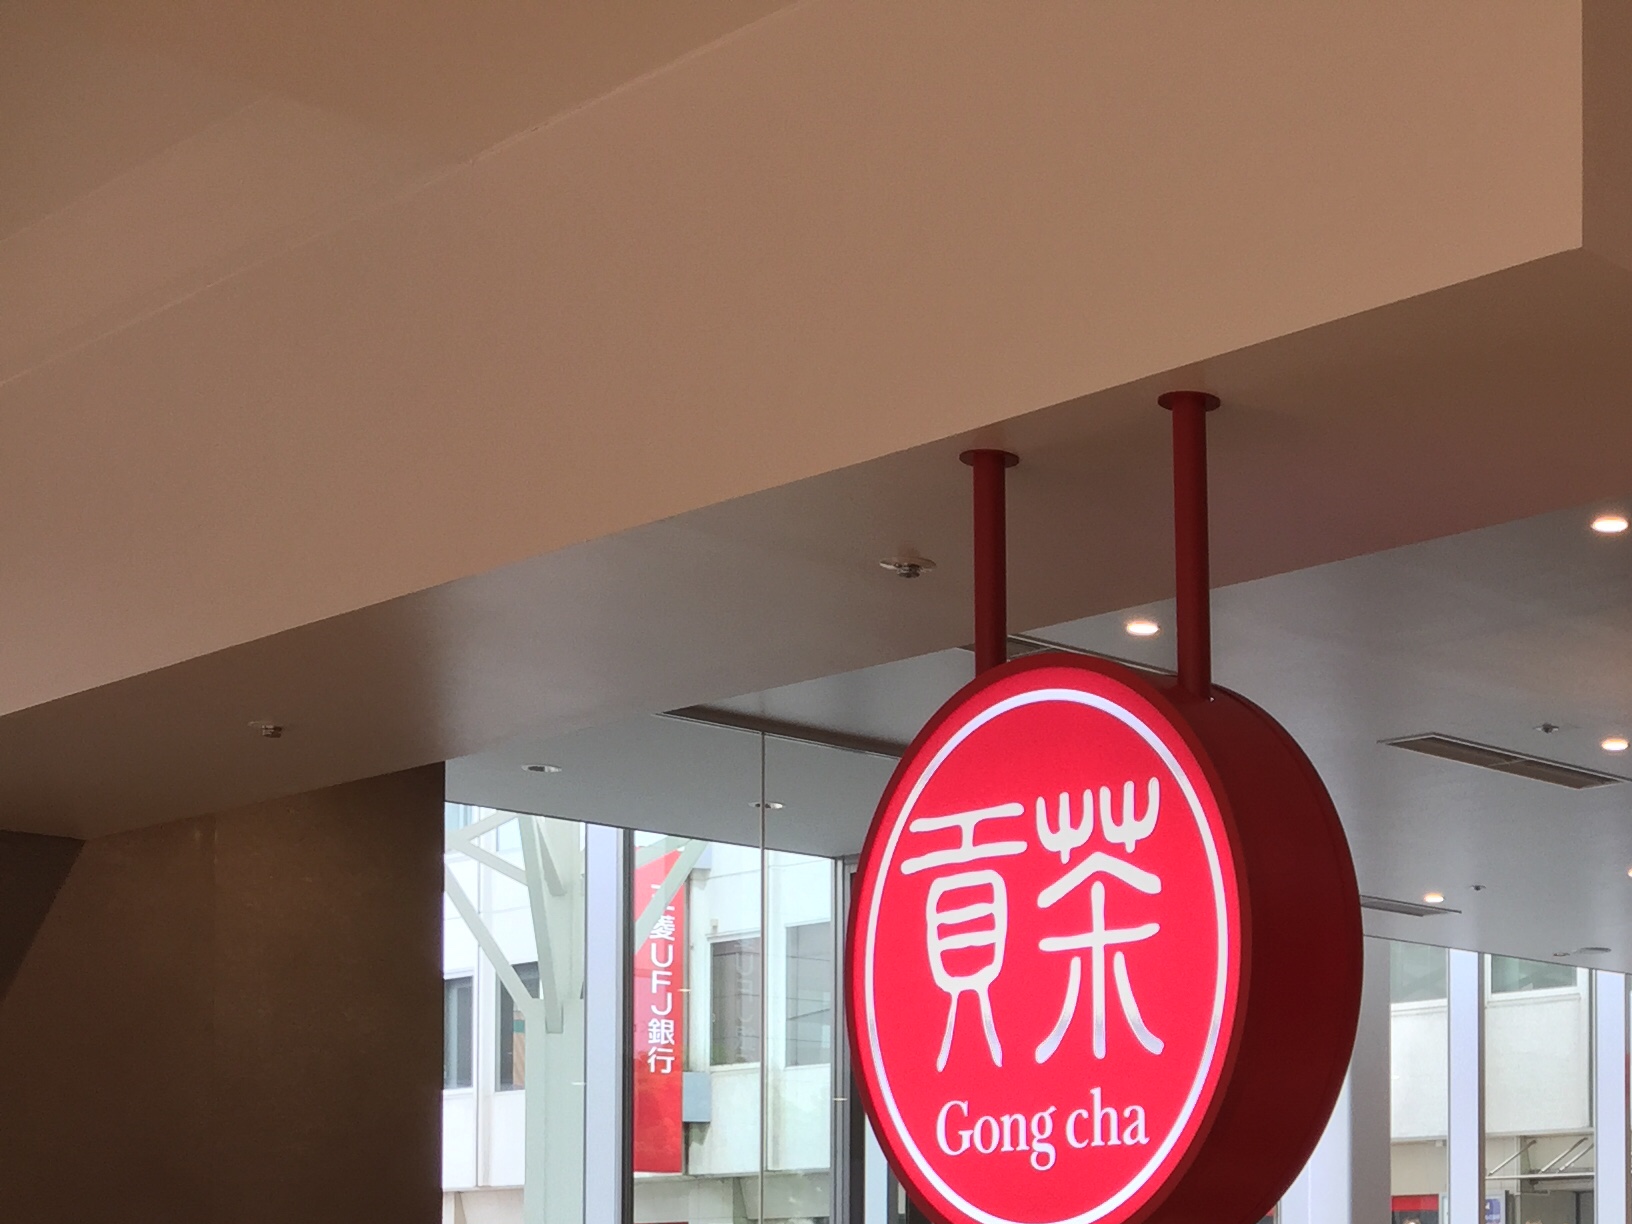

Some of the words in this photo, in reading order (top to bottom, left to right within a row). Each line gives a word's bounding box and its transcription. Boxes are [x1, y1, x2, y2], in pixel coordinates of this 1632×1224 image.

[900, 776, 1164, 1073] 貢茶
[935, 1099, 1056, 1172] Gong
[1066, 1086, 1150, 1147] cha
